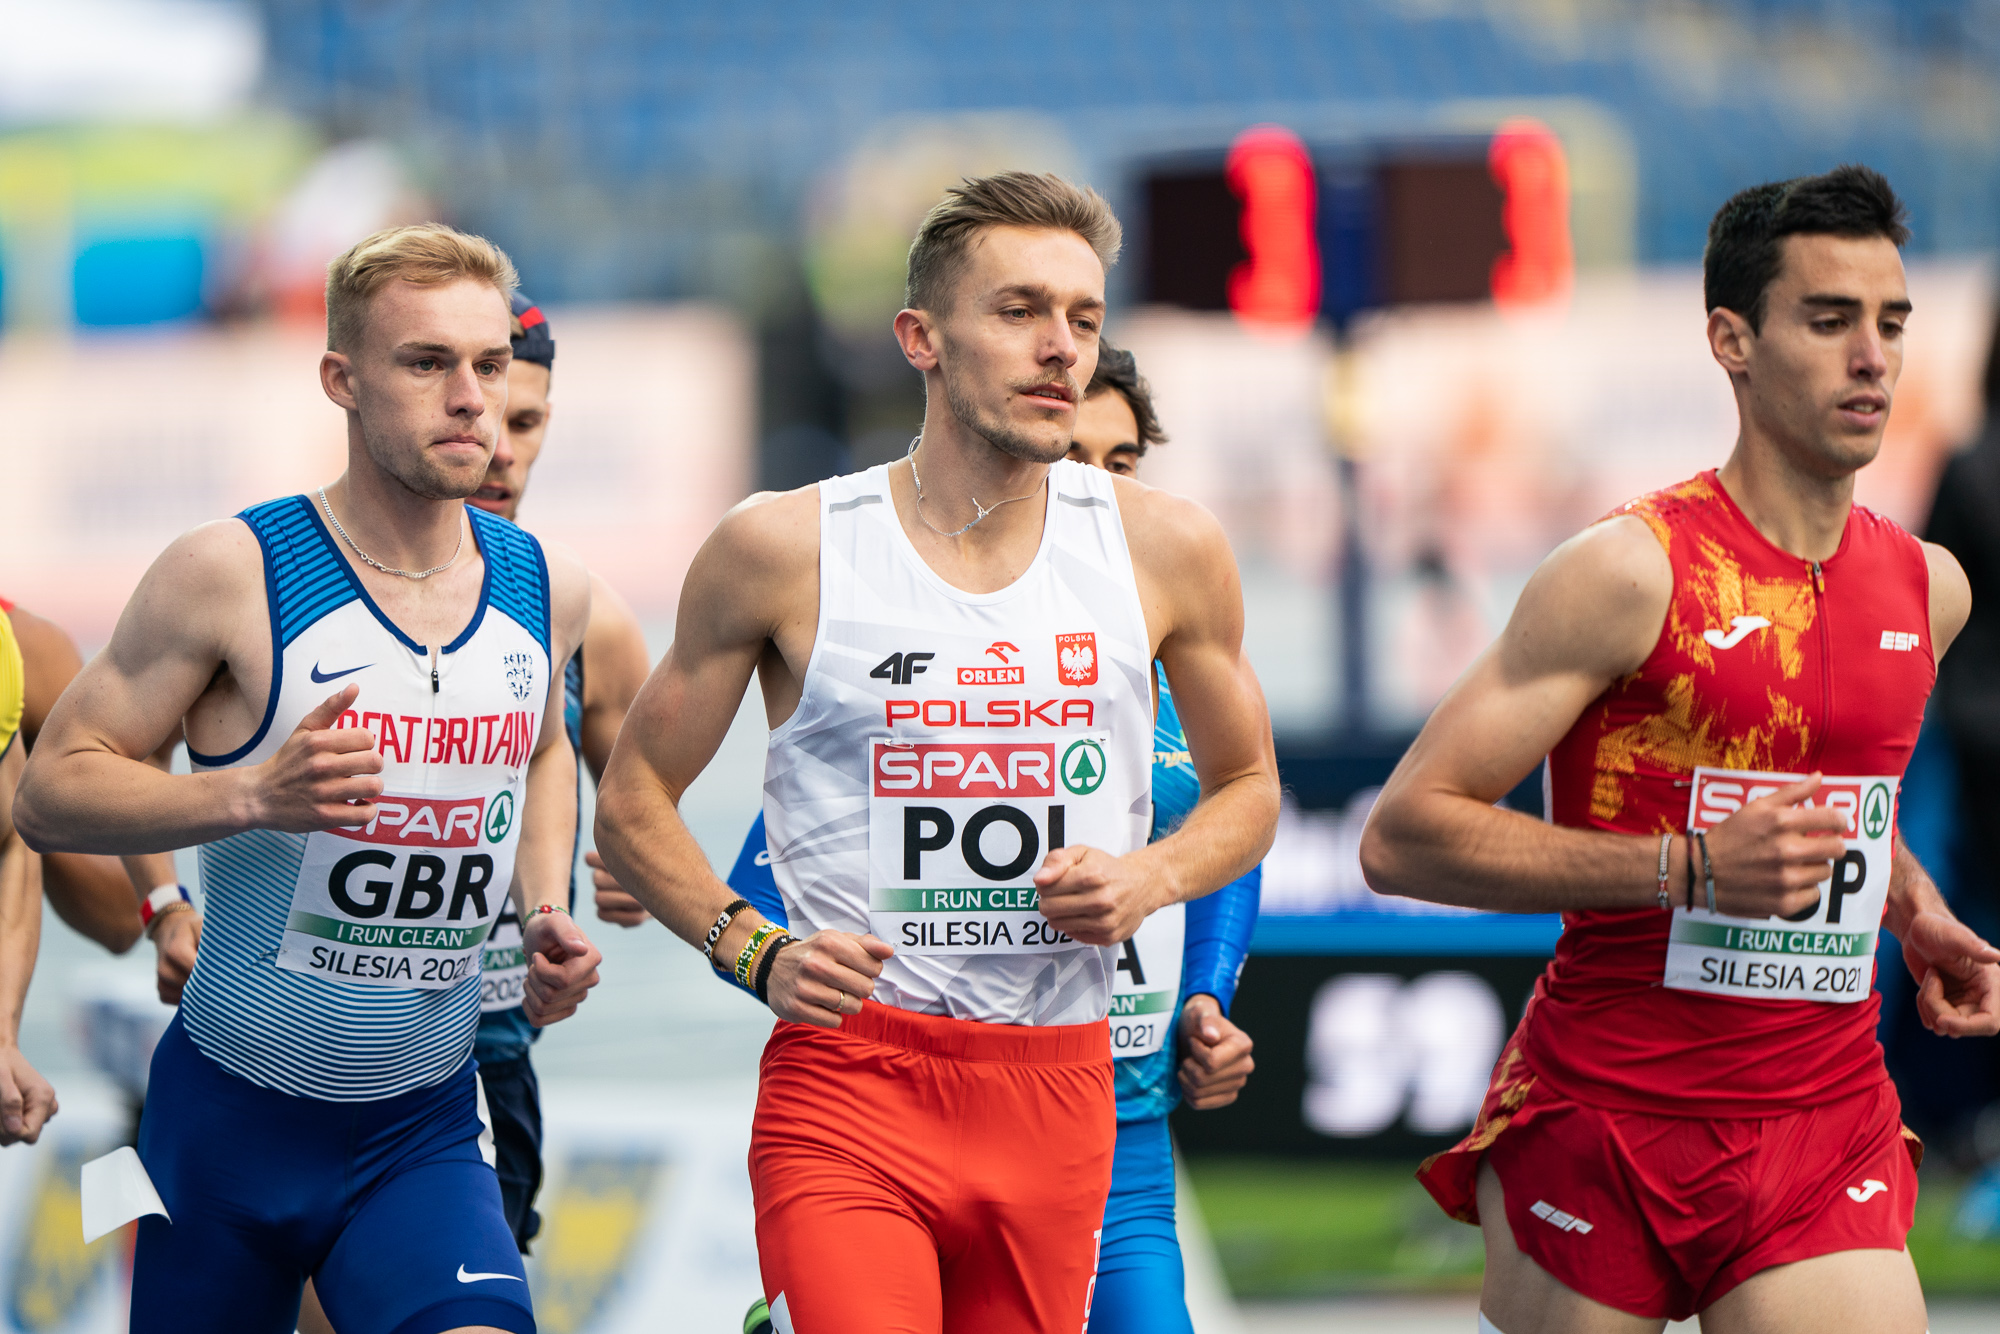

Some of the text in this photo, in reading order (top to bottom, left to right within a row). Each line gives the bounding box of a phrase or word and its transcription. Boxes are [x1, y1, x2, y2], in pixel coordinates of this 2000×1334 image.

[1058, 634, 1093, 643] POLSKA
[1880, 630, 1919, 651] ESP
[870, 652, 935, 684] 4F
[960, 669, 1020, 683] ORLEN
[886, 699, 1094, 727] POLSKA
[422, 711, 534, 769] BRITAIN
[879, 751, 1050, 790] SPAR
[338, 802, 480, 841] PAR
[328, 849, 494, 921] GBR
[921, 890, 1042, 909] I RUN CLEA
[337, 923, 344, 939] I
[349, 926, 394, 945] RUN
[902, 921, 1013, 947] SILESIA
[1725, 928, 1731, 946] I
[1738, 929, 1784, 952] RUN
[309, 945, 412, 980] SILESIA
[1700, 957, 1862, 994] SILESIA 2021
